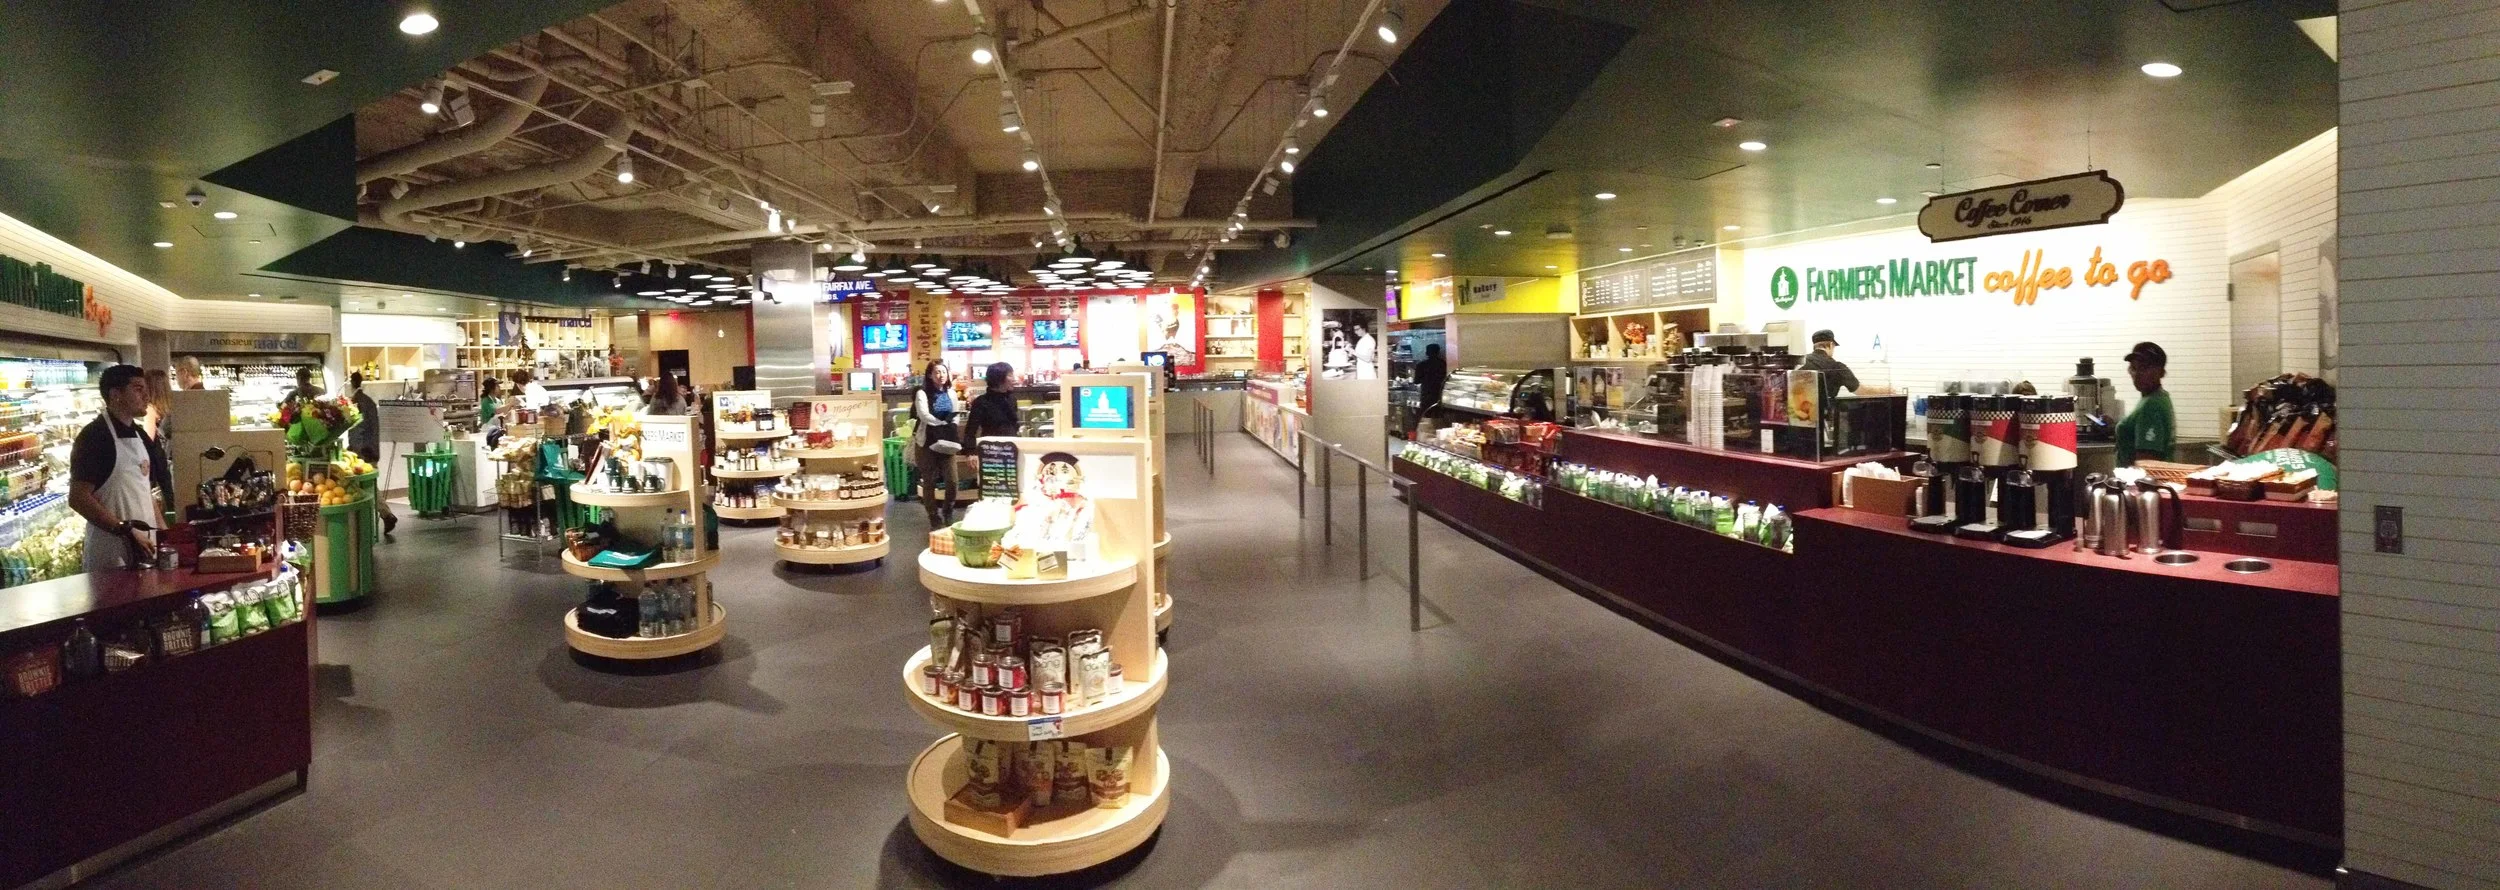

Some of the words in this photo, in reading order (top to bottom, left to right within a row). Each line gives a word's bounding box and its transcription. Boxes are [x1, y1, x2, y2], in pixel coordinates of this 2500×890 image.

[1954, 197, 2008, 228] Coffee
[2009, 188, 2072, 216] Corner
[823, 281, 854, 291] FAIRFAX
[1807, 265, 1886, 302] FARMERS
[1888, 257, 1978, 298] MARKET
[1984, 248, 2074, 306] coffee
[2085, 246, 2119, 287] to
[2127, 259, 2173, 301] go
[1872, 333, 1882, 350] A
